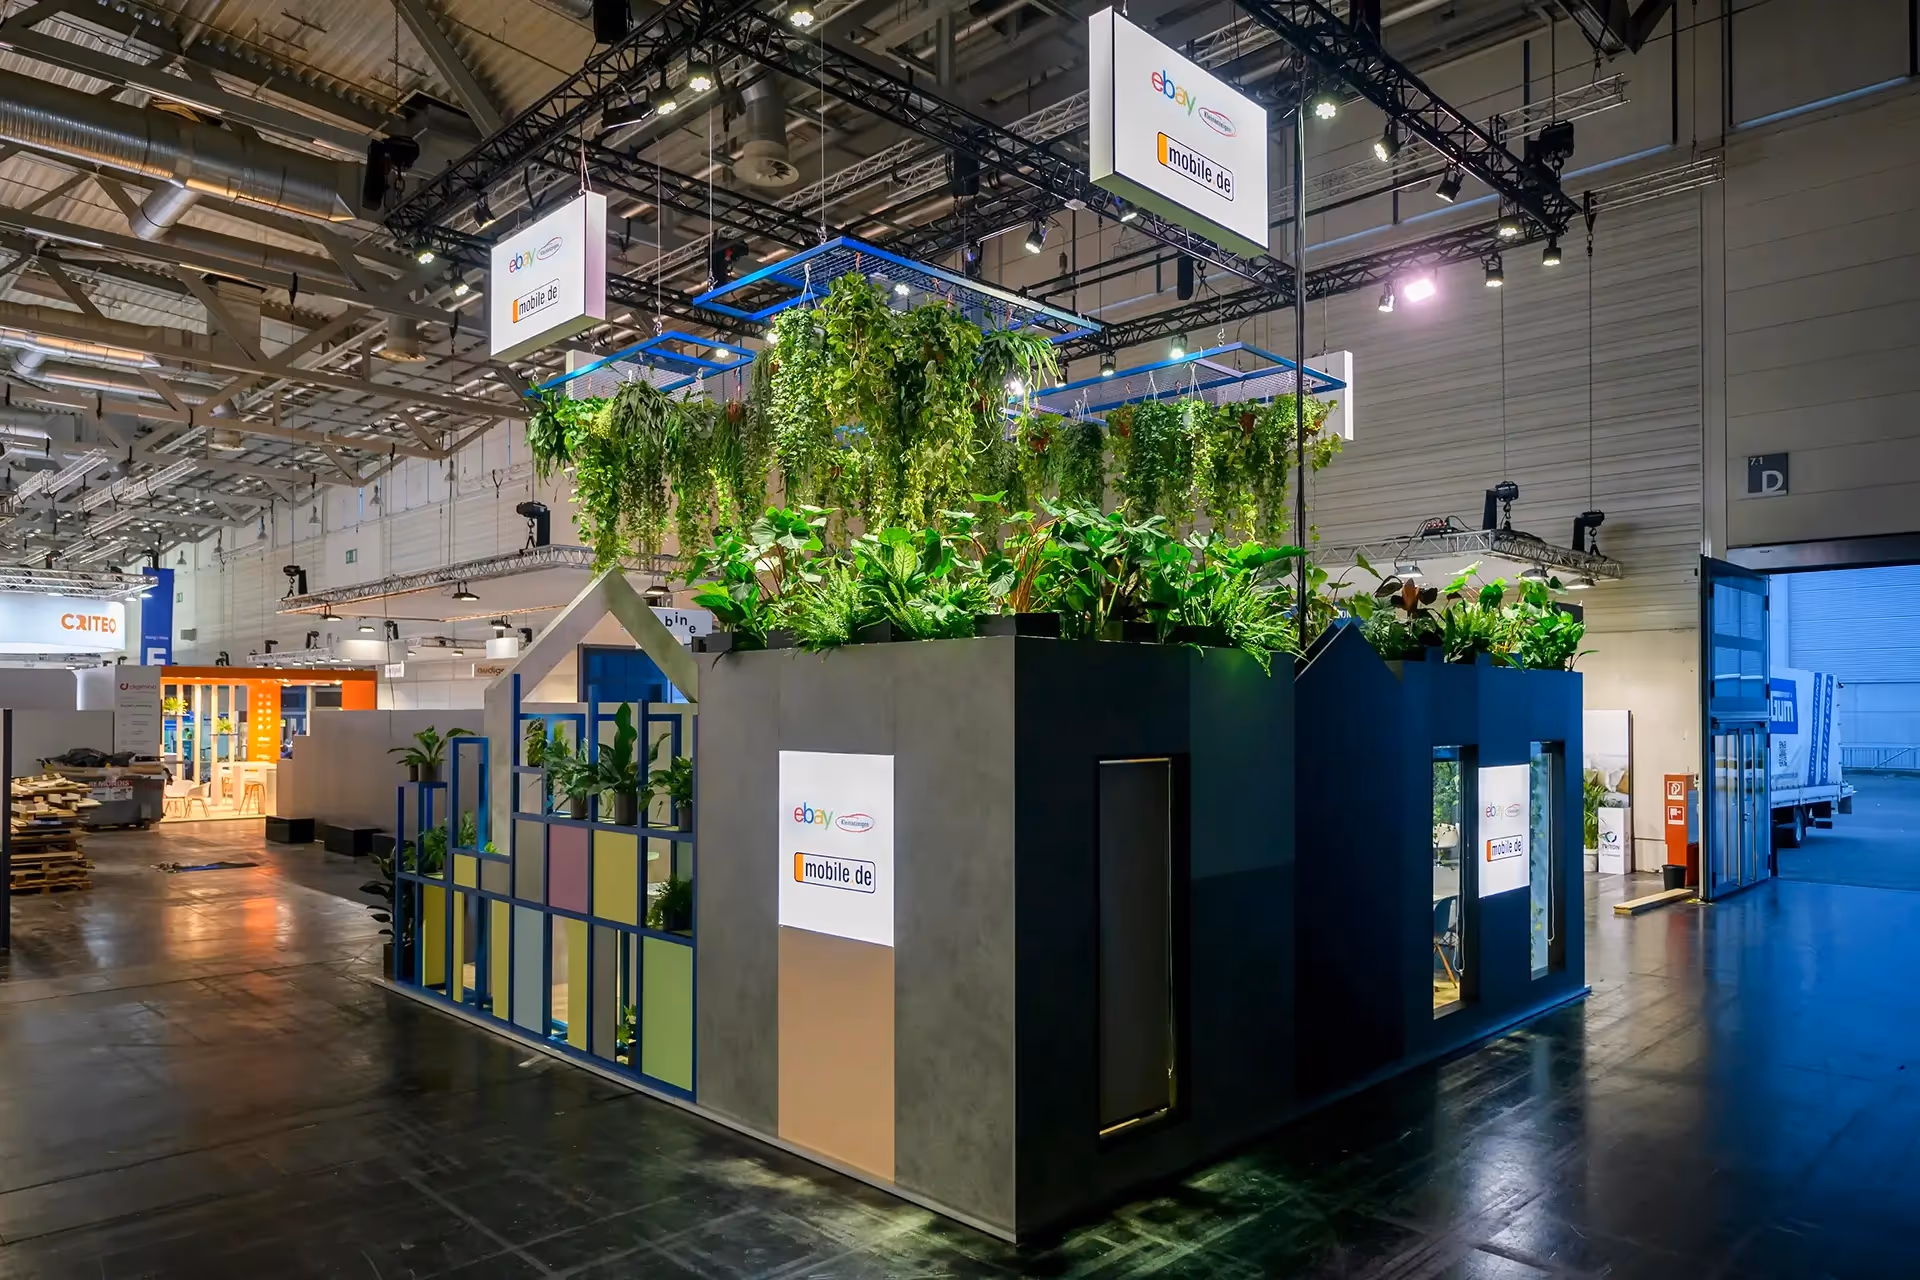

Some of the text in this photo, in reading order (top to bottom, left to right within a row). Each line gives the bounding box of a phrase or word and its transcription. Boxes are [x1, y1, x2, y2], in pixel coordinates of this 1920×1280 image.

[1151, 69, 1196, 116] ebay
[1168, 145, 1231, 194] mobile.de
[509, 247, 536, 273] ebay
[518, 285, 558, 315] mobilede
[1750, 456, 1763, 466] 7.1
[1762, 470, 1784, 493] D
[61, 613, 117, 634] CRITEO
[794, 801, 834, 831] ebay
[805, 860, 872, 886] mobile.de
